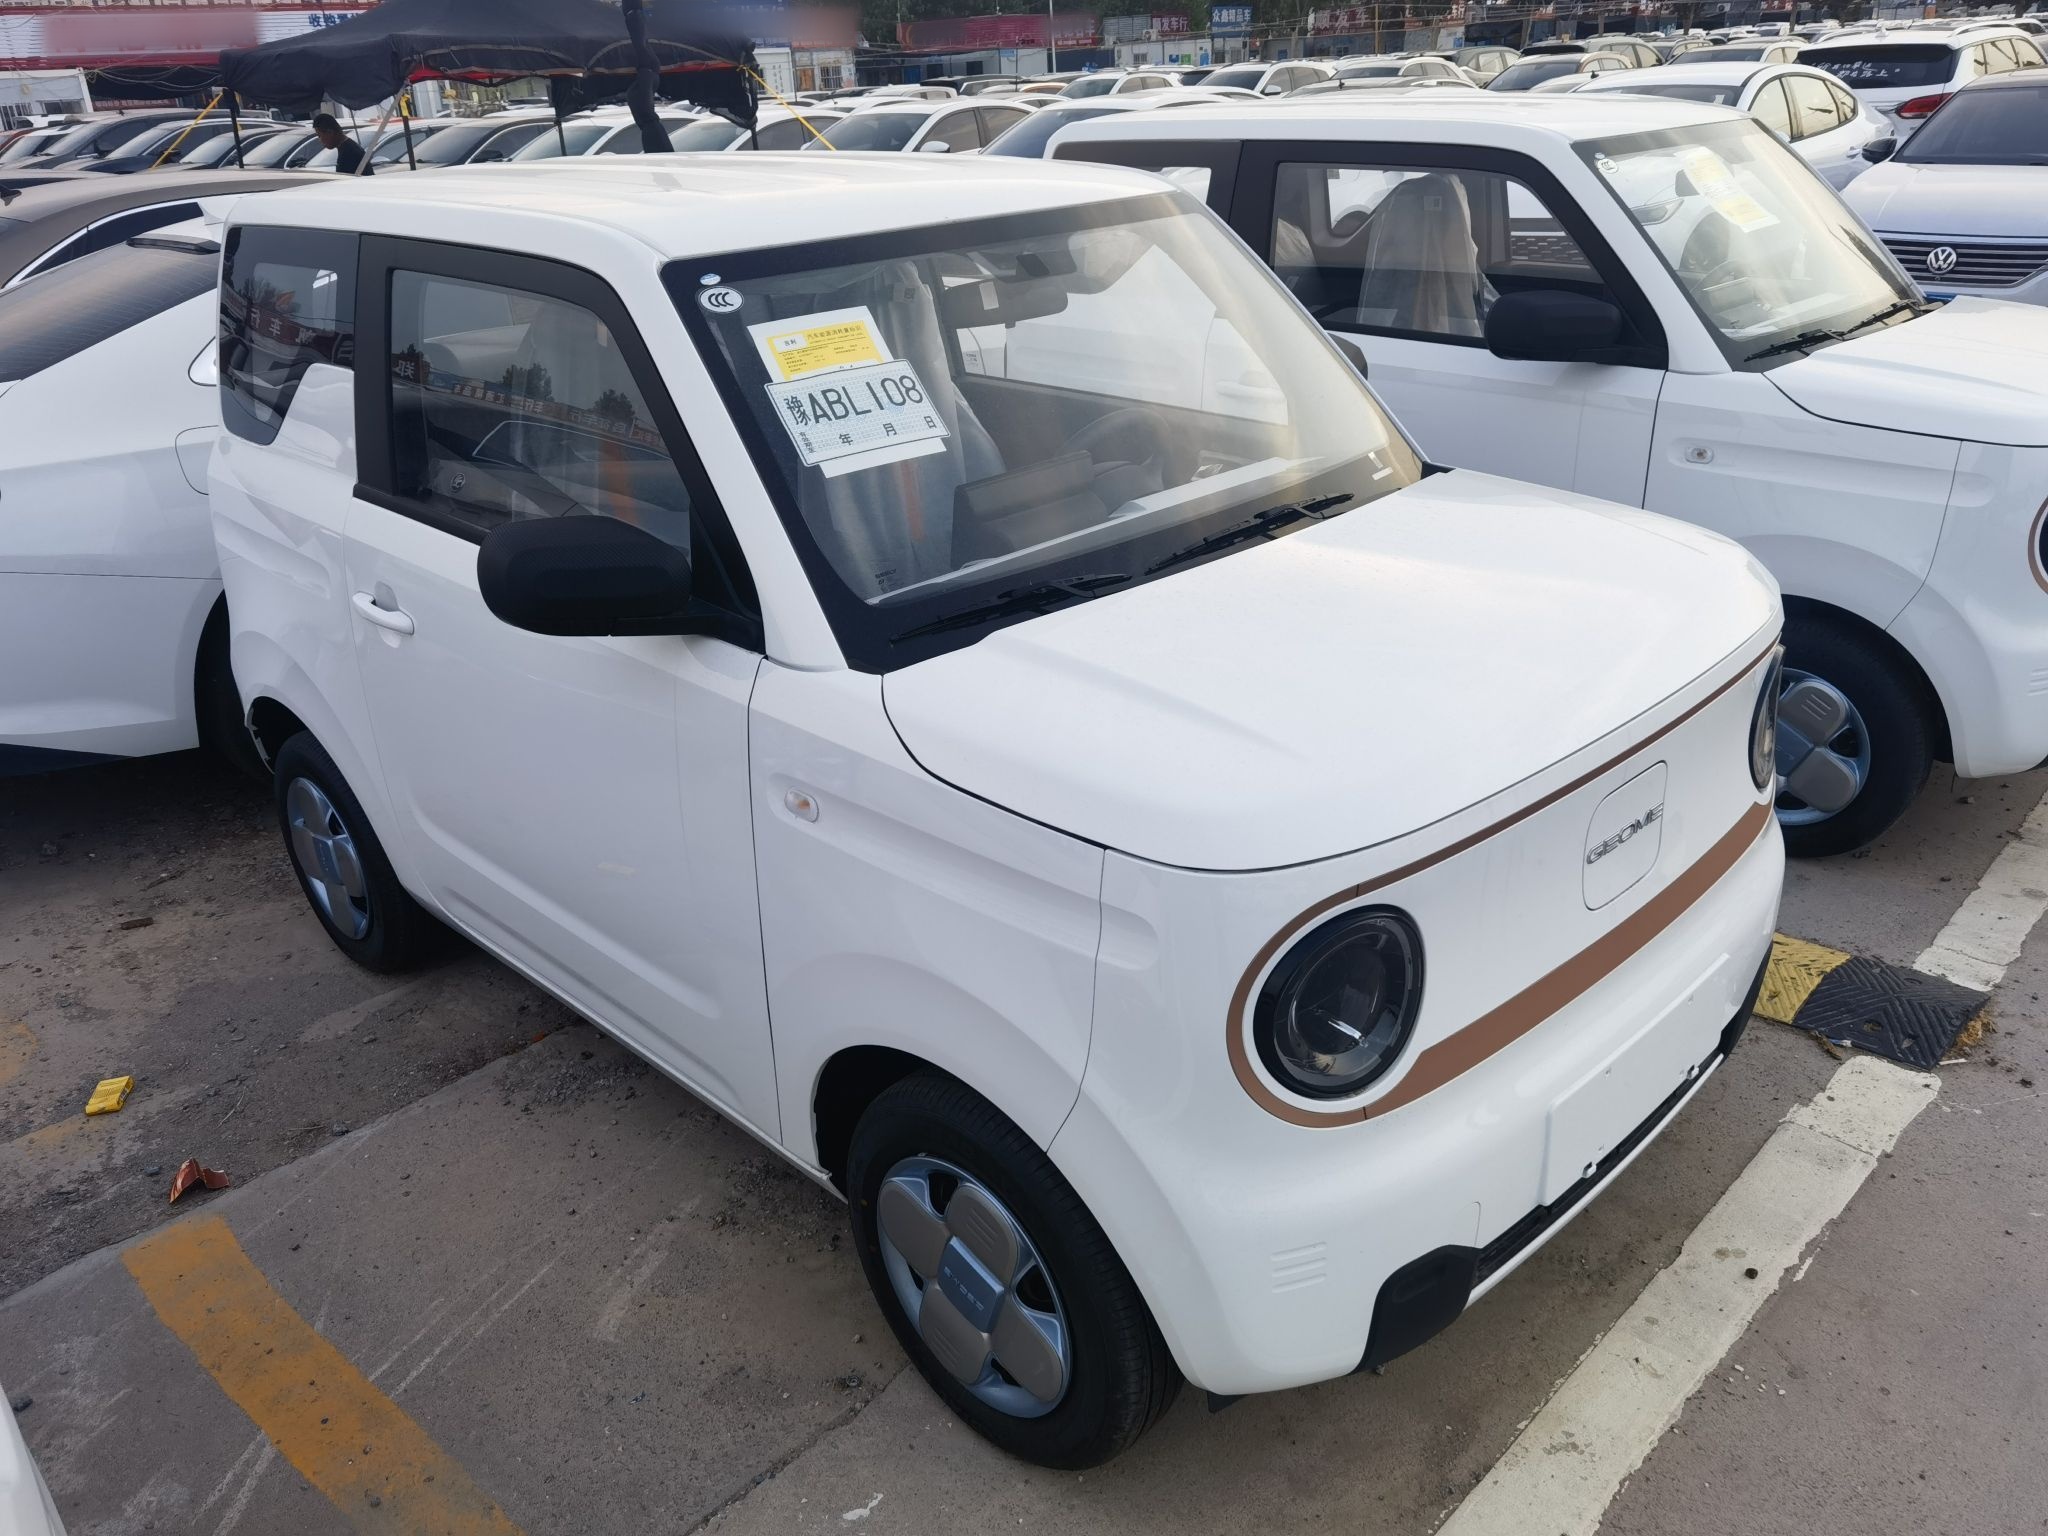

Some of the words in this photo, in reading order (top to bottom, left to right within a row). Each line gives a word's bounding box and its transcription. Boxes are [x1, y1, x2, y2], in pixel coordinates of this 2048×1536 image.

[708, 291, 734, 308] CCC
[838, 433, 853, 446] 年
[882, 422, 898, 437] 月
[923, 415, 937, 429] 日
[1586, 801, 1664, 864] GEOME
